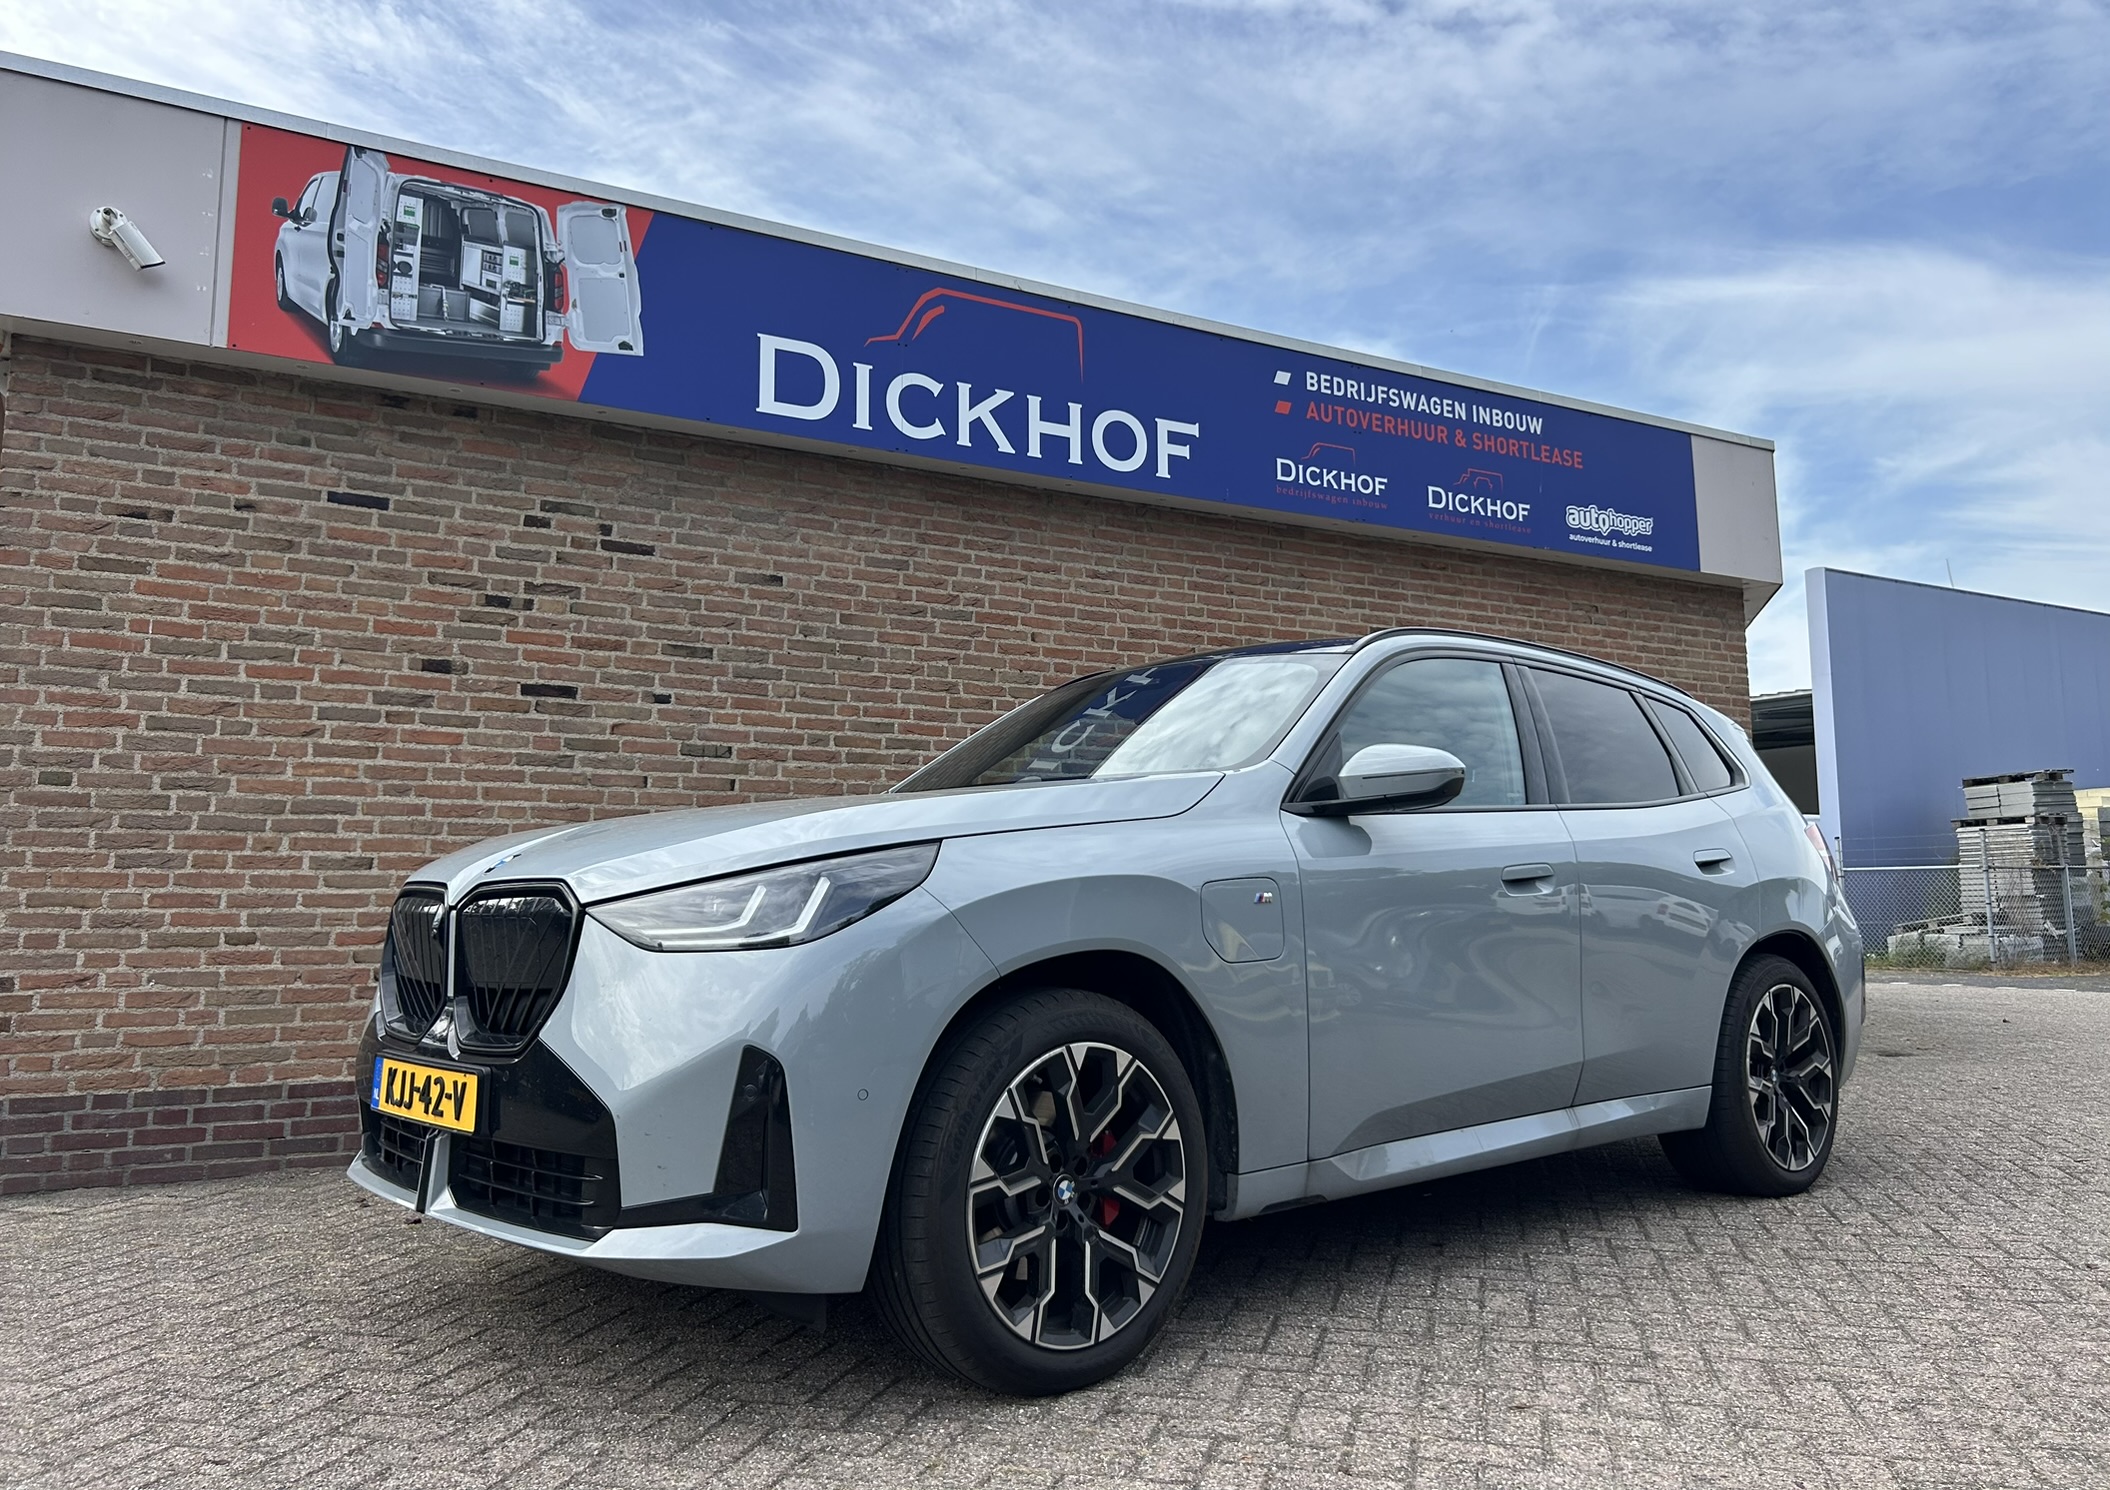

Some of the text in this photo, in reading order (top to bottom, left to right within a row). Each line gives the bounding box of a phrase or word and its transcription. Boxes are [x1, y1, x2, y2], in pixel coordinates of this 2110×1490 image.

[1305, 371, 1543, 435] BEDRIJFSWAGEN INBOUW
[1306, 400, 1584, 469] AUTOVERHUUR & SHORTLEASE
[1276, 485, 1389, 510] bedrijfswagen inbouw
[1428, 512, 1532, 534] verhuur en shortlease
[1566, 505, 1653, 536] autohopper
[1568, 534, 1611, 546] autoverhuur
[1618, 541, 1653, 552] shortlease
[385, 1066, 467, 1122] KJJ-42-V
